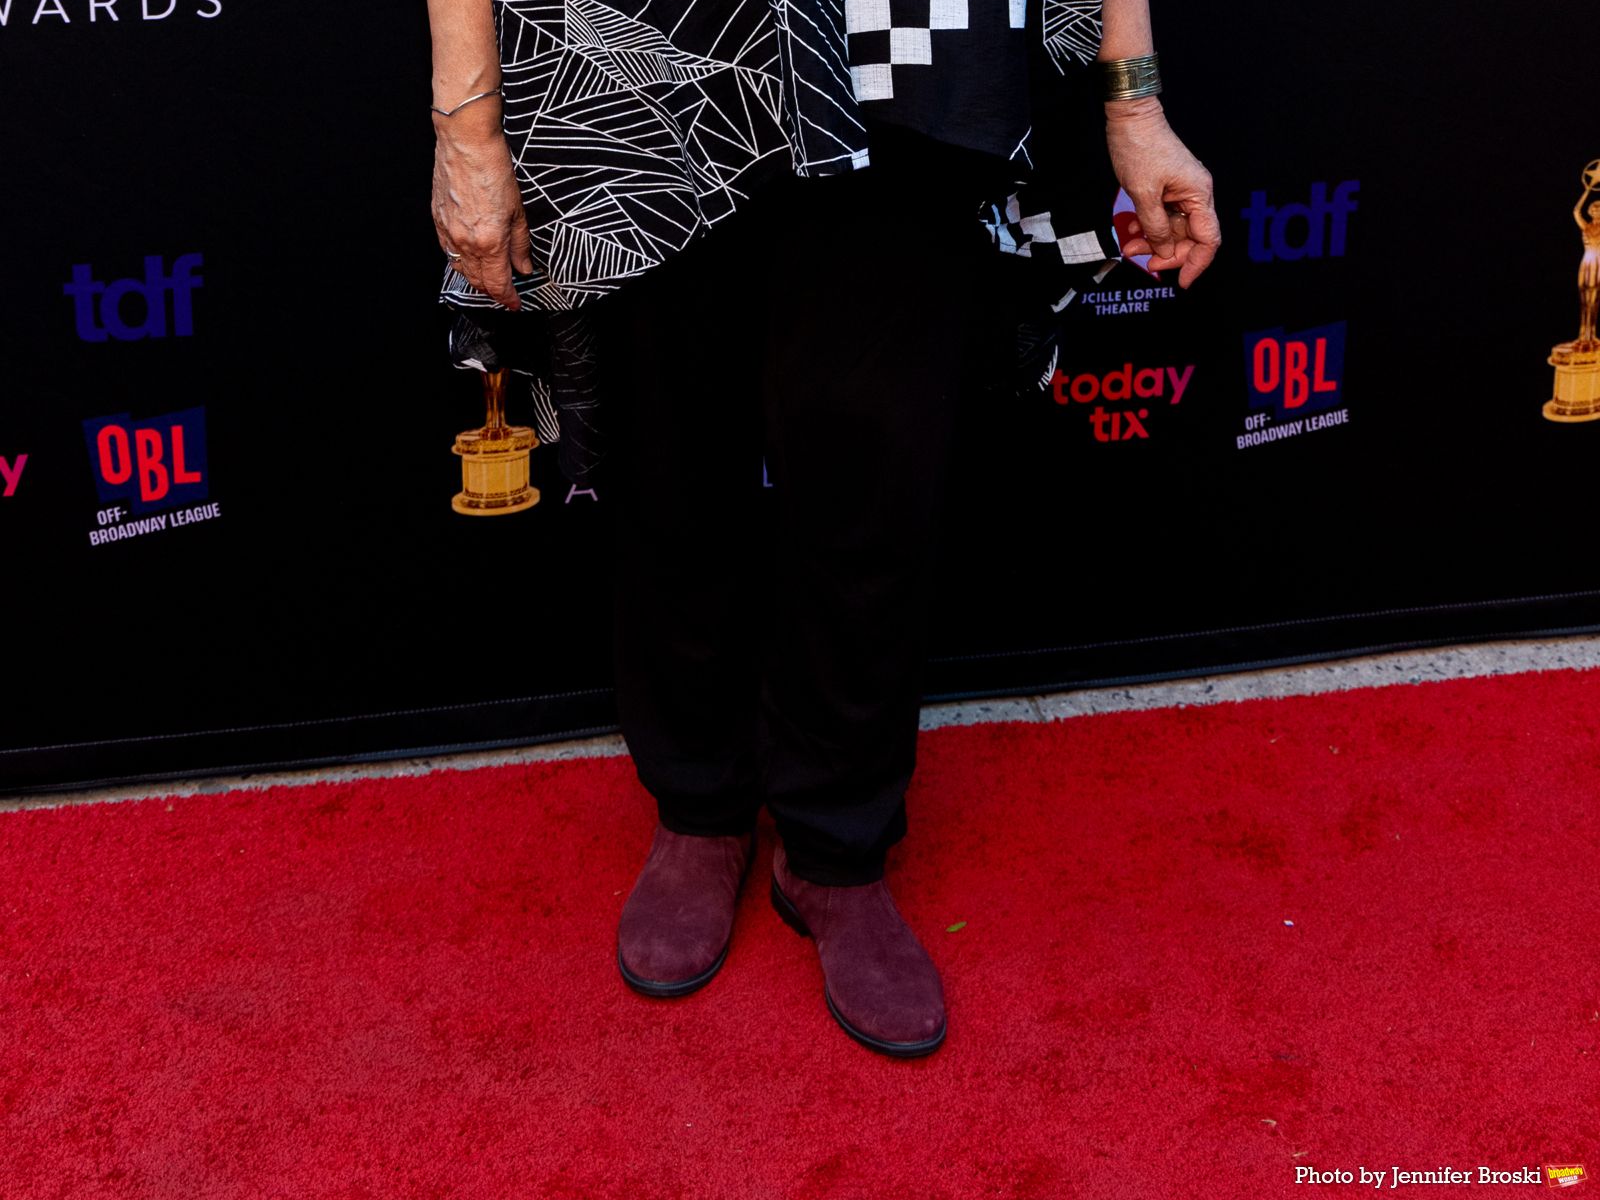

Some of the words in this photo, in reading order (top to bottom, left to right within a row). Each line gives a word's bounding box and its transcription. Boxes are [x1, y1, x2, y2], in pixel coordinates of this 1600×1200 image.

[1240, 180, 1361, 263] tdf
[63, 252, 206, 343] tdf
[1094, 301, 1150, 316] THEATRE
[1127, 286, 1176, 300] LORTEL
[1050, 362, 1196, 406] today
[1253, 337, 1338, 409] OBL
[1089, 406, 1151, 442] tix
[1236, 421, 1303, 450] BROADWAY
[1305, 408, 1350, 432] LEAGUE
[1244, 412, 1272, 431] OFF-
[97, 424, 202, 502] OBL
[88, 514, 167, 547] BROADWAY
[169, 502, 222, 528] LEAGUE
[97, 505, 128, 526] OFF-
